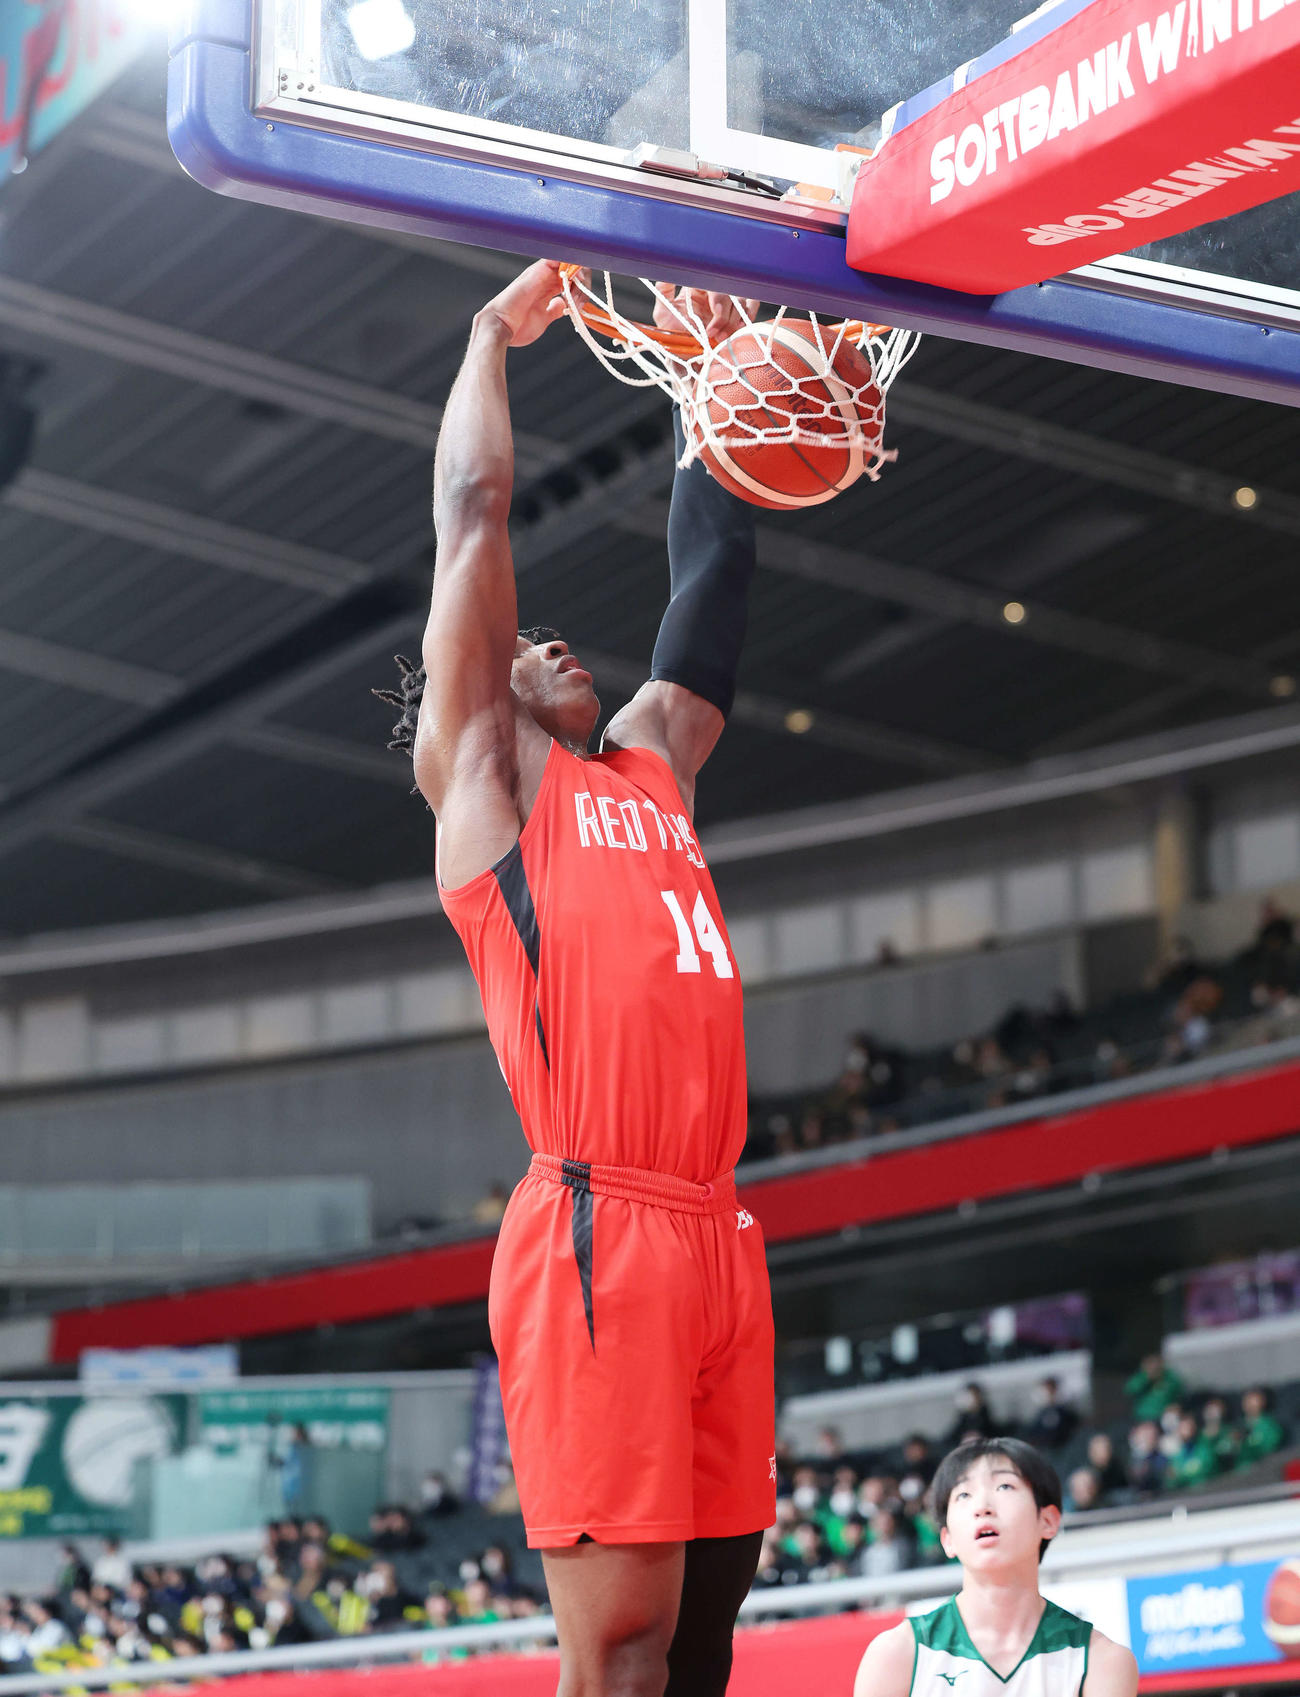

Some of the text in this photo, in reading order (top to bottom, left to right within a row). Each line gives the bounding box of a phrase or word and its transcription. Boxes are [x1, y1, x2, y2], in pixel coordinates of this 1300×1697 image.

[930, 32, 1135, 205] SOFTBANK
[1021, 138, 1300, 246] WINTER CUP
[574, 791, 649, 853] RED
[660, 889, 734, 979] 14
